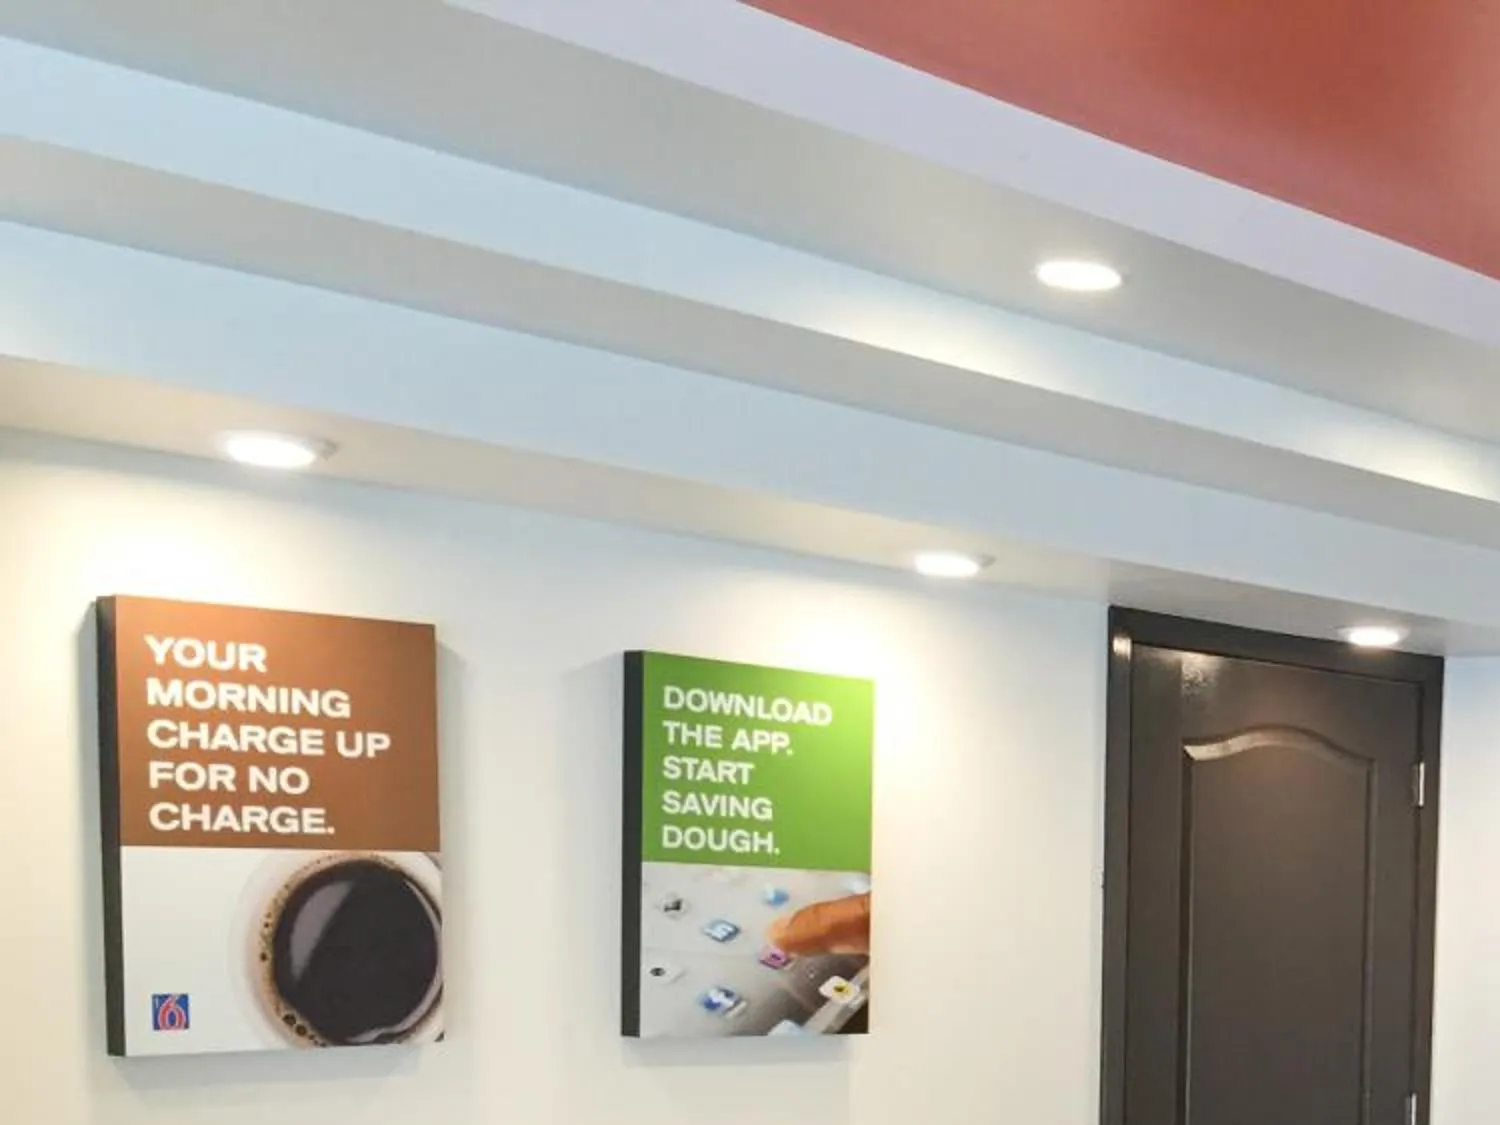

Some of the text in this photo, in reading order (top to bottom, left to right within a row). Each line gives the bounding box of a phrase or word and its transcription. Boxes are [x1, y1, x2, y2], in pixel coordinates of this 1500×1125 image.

[145, 634, 268, 673] YOUR
[146, 678, 351, 718] MORNING
[663, 685, 832, 725] DOWNLOAD
[147, 720, 391, 759] CHARGE UP
[663, 720, 794, 757] THE APP.
[149, 762, 310, 796] FOR NO
[662, 755, 754, 786] START
[149, 803, 335, 836] CHARGE.
[662, 791, 773, 821] SAVING
[662, 825, 780, 855] DOUGH.
